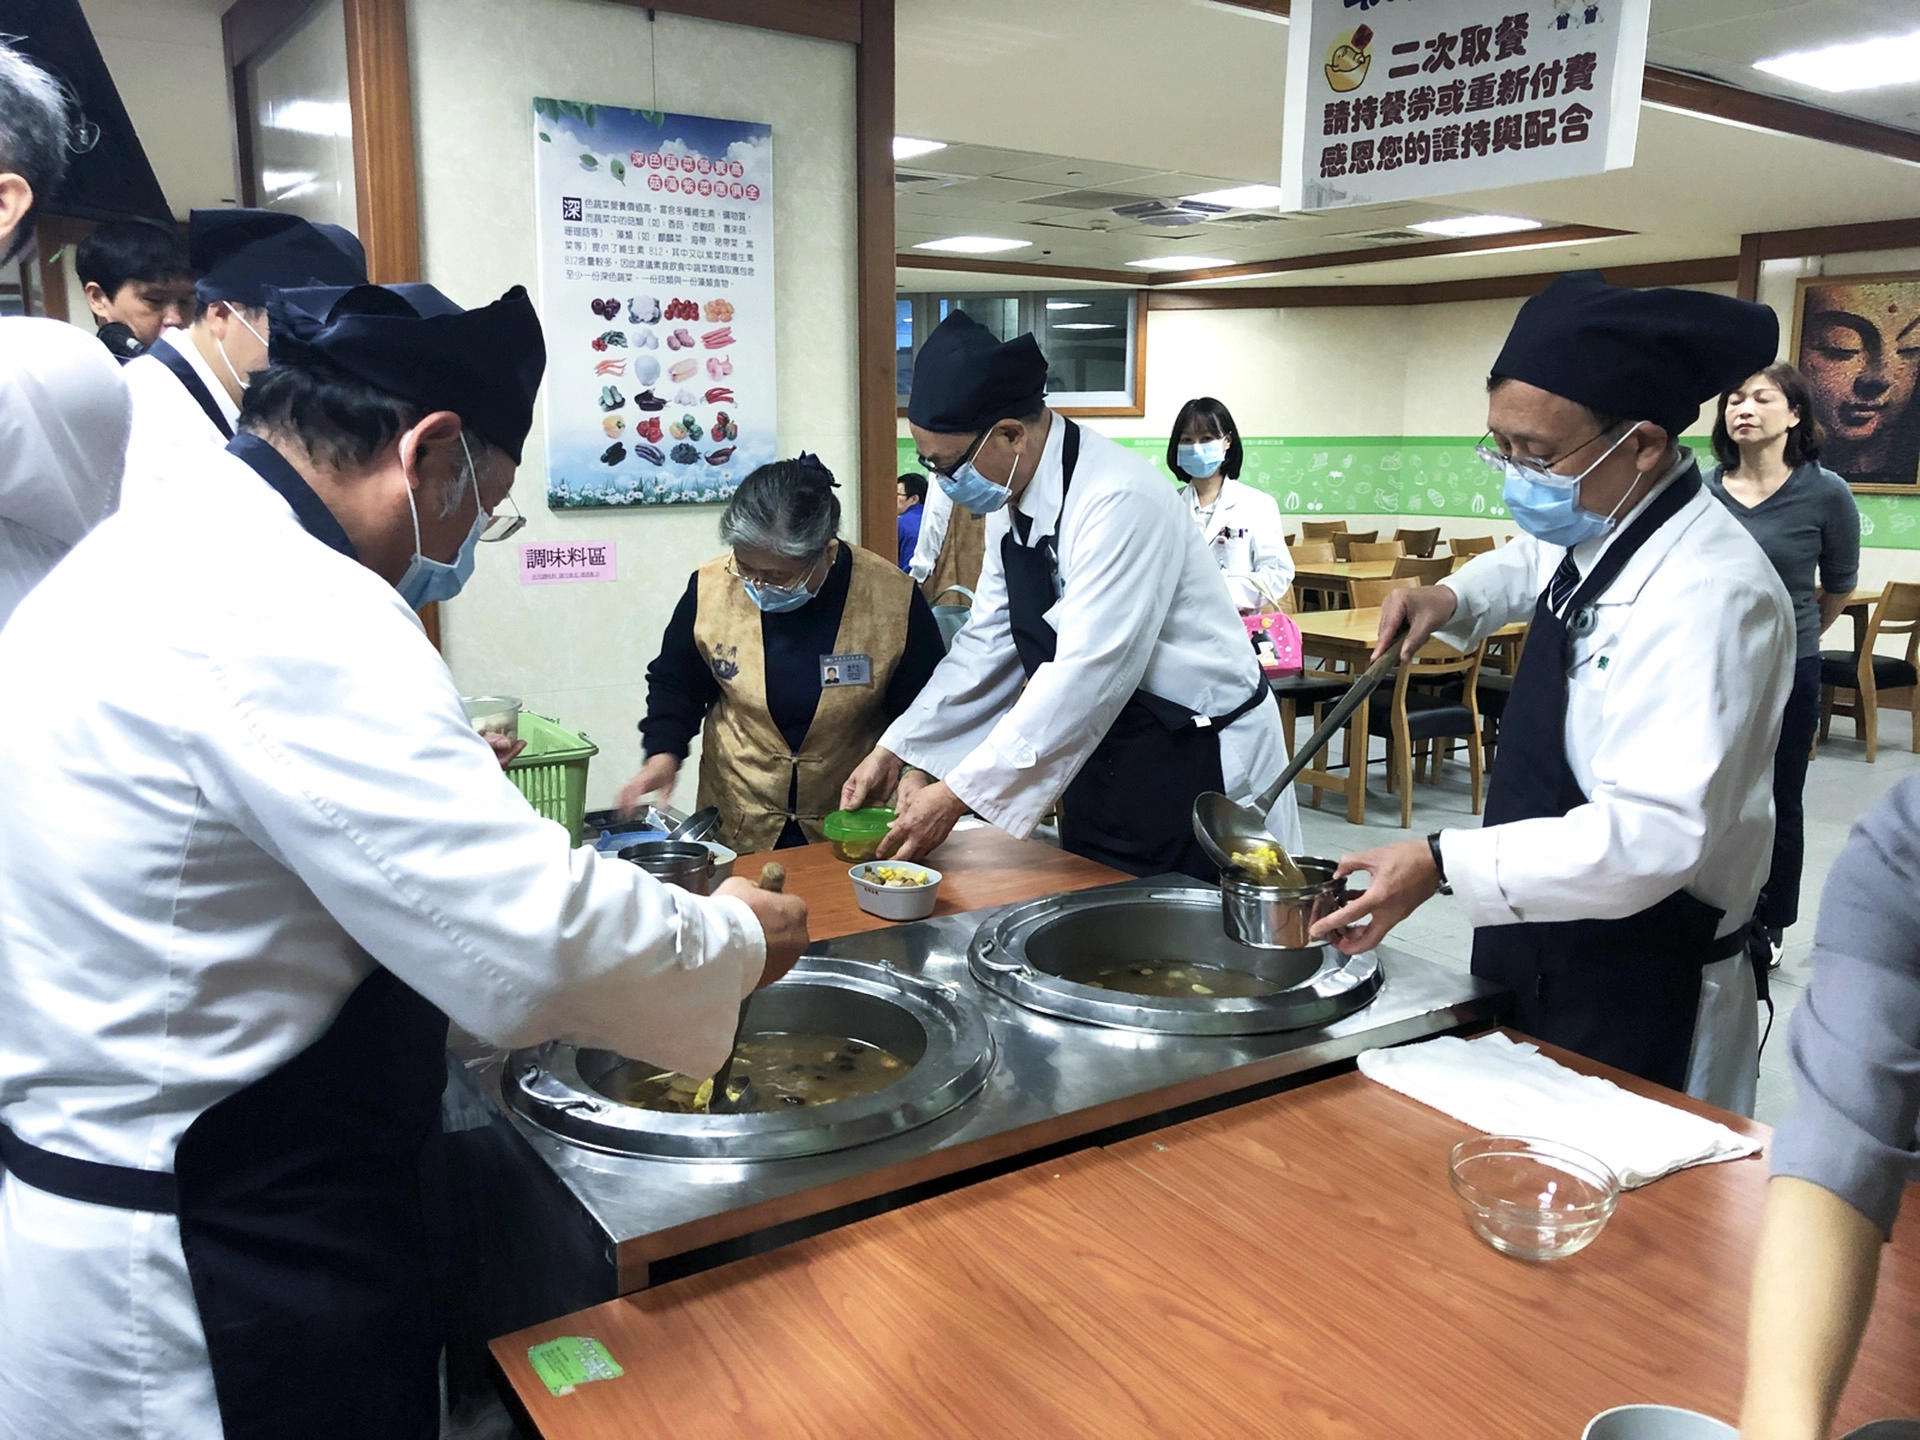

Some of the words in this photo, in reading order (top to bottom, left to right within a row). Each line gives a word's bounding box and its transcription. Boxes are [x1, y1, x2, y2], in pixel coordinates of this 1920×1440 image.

[1388, 12, 1530, 79] 二次取餐
[1323, 52, 1597, 136] 請持餐券或重新付費
[1320, 102, 1593, 178] 感恩您的護持與配合
[563, 198, 581, 220] 深
[525, 546, 606, 570] 調味料區
